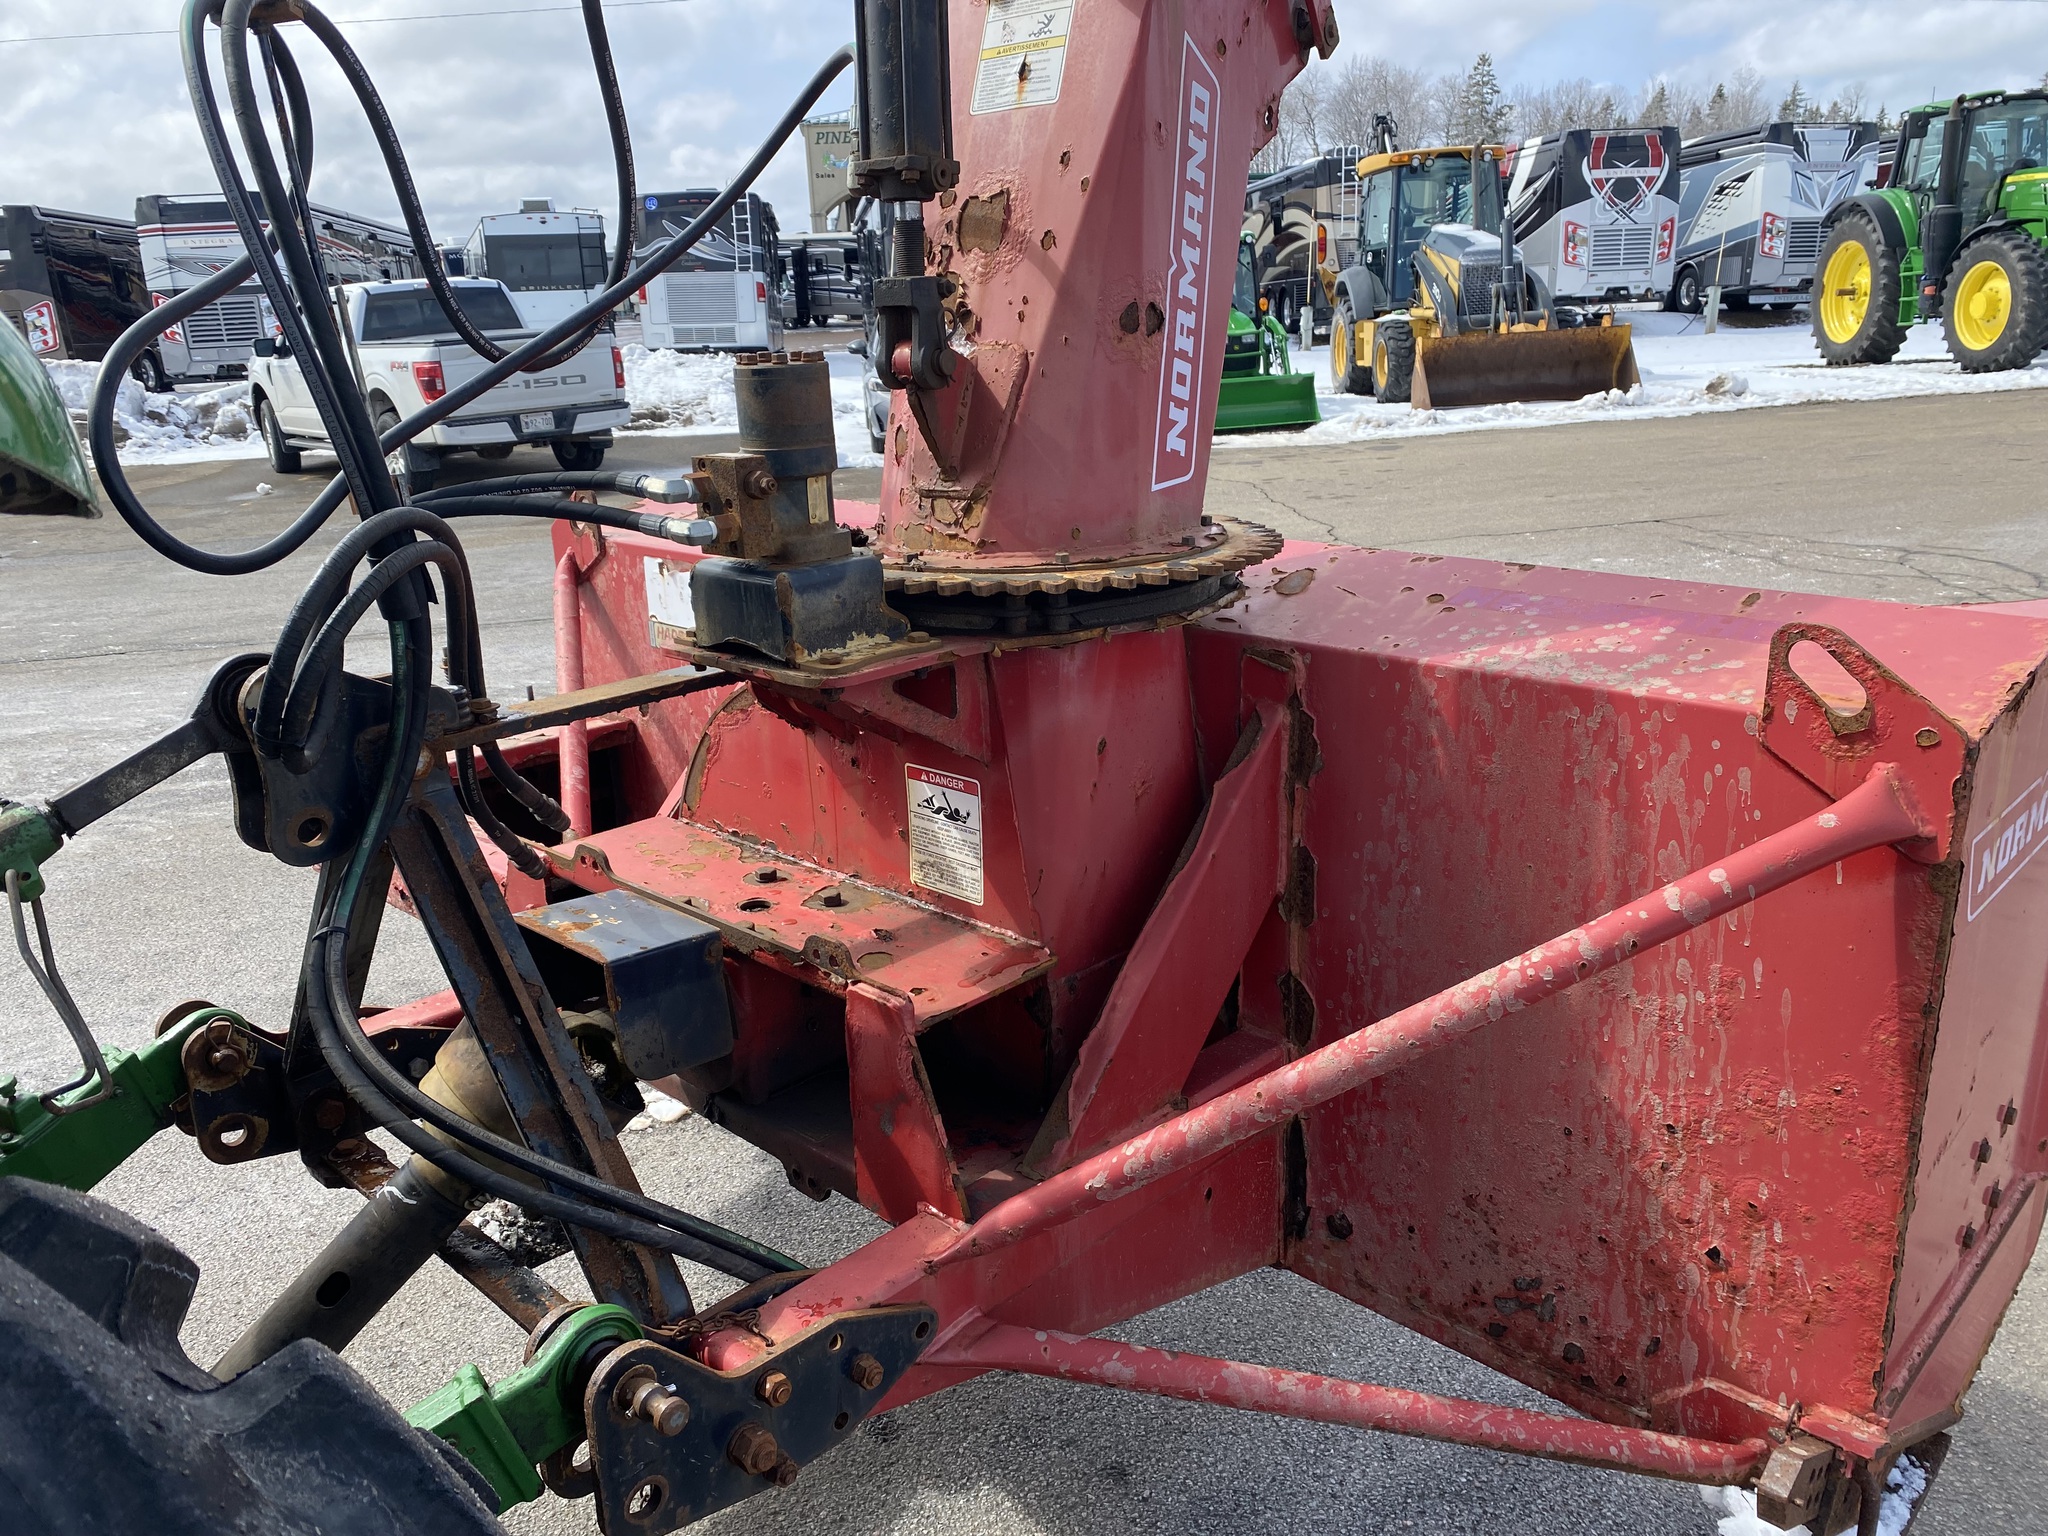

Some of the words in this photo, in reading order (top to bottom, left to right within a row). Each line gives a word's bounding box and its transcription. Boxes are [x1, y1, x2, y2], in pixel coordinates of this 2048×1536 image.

[1002, 40, 1049, 54] AVERTISSEMENT
[1166, 80, 1210, 457] NORMAND
[390, 361, 408, 372] FX4
[929, 773, 964, 790] DANGER
[1977, 790, 2048, 894] NORM
